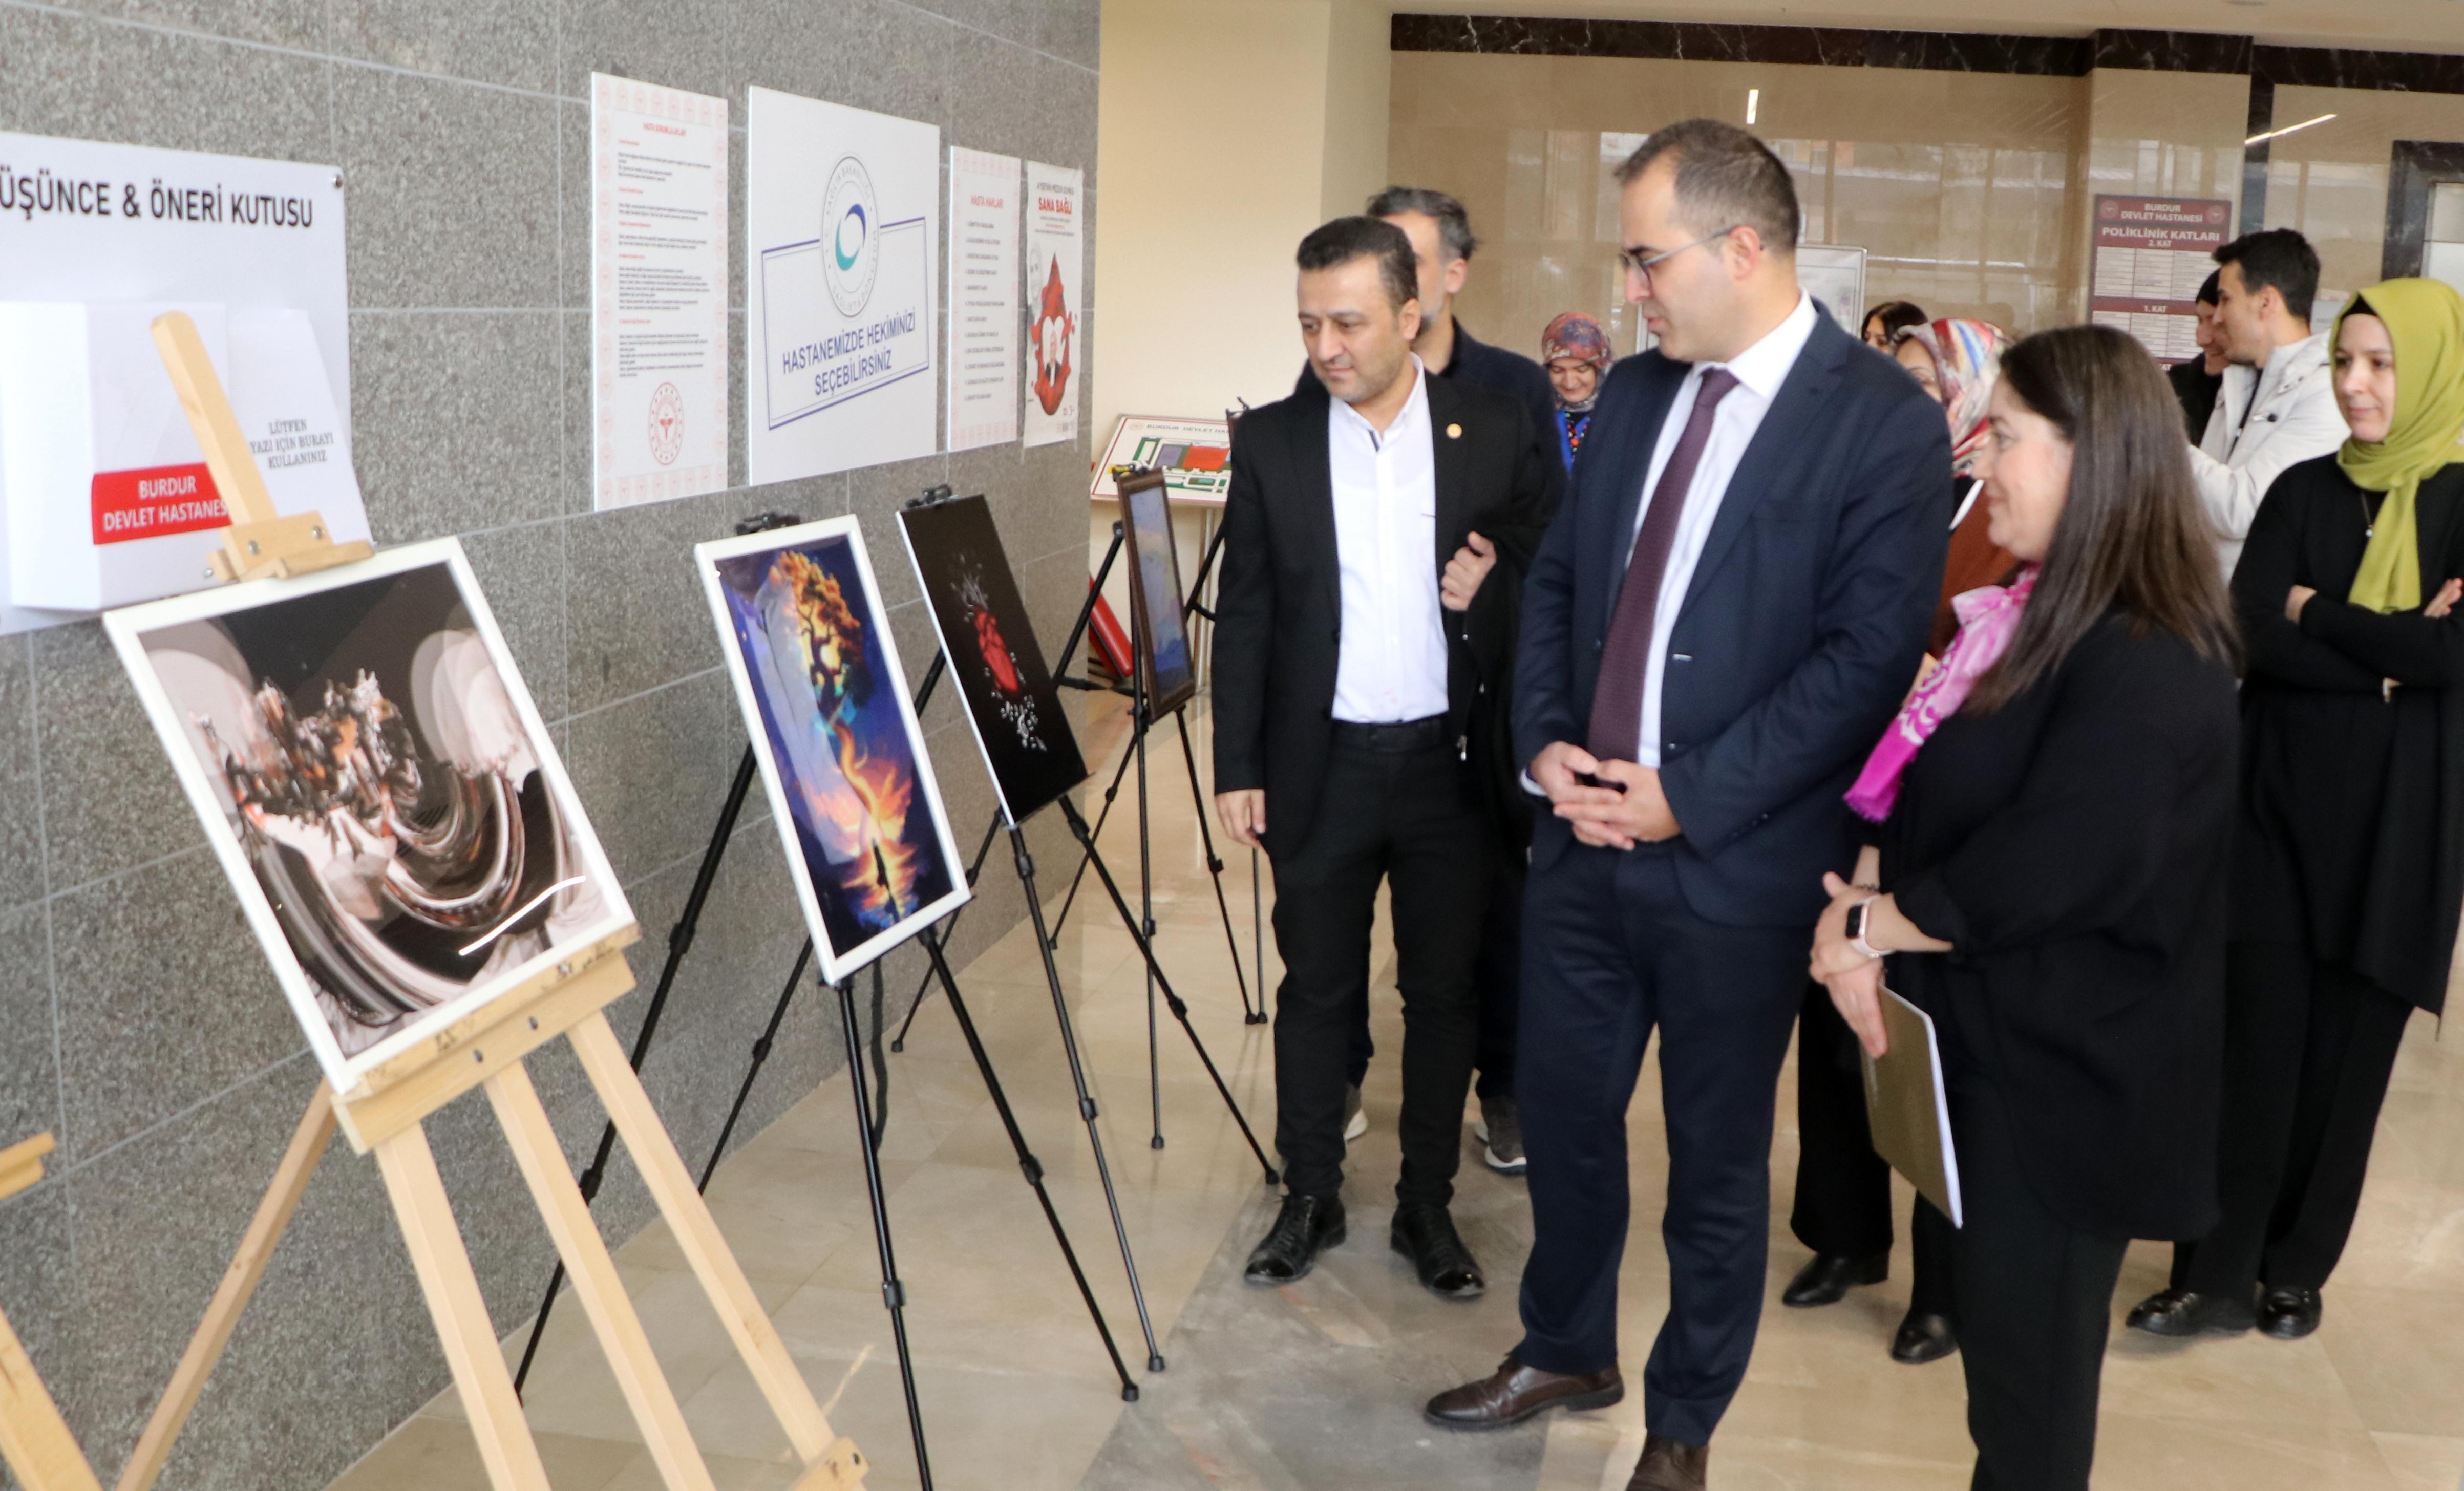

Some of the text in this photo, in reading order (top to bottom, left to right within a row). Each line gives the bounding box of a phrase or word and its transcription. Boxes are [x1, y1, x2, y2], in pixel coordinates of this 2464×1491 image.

[0, 166, 313, 227] ÜŞÜNCE & ÖNERİ KUTUSU
[1038, 196, 1054, 211] SANA
[2144, 203, 2181, 212] BURDUR
[2121, 211, 2203, 222] DEVLET HASTANESİ
[2102, 226, 2220, 242] POLİKLİNİK KATLARI
[783, 306, 916, 374] HASTANEMİZDE HEKİMİNİZİ
[815, 346, 892, 396] SEÇEBİLİRSİNİZ
[269, 418, 307, 434] LÜTFEN
[298, 432, 334, 448] BURAYI
[138, 475, 197, 500] BURDUR
[103, 498, 229, 532] DEVLET HASTANES
